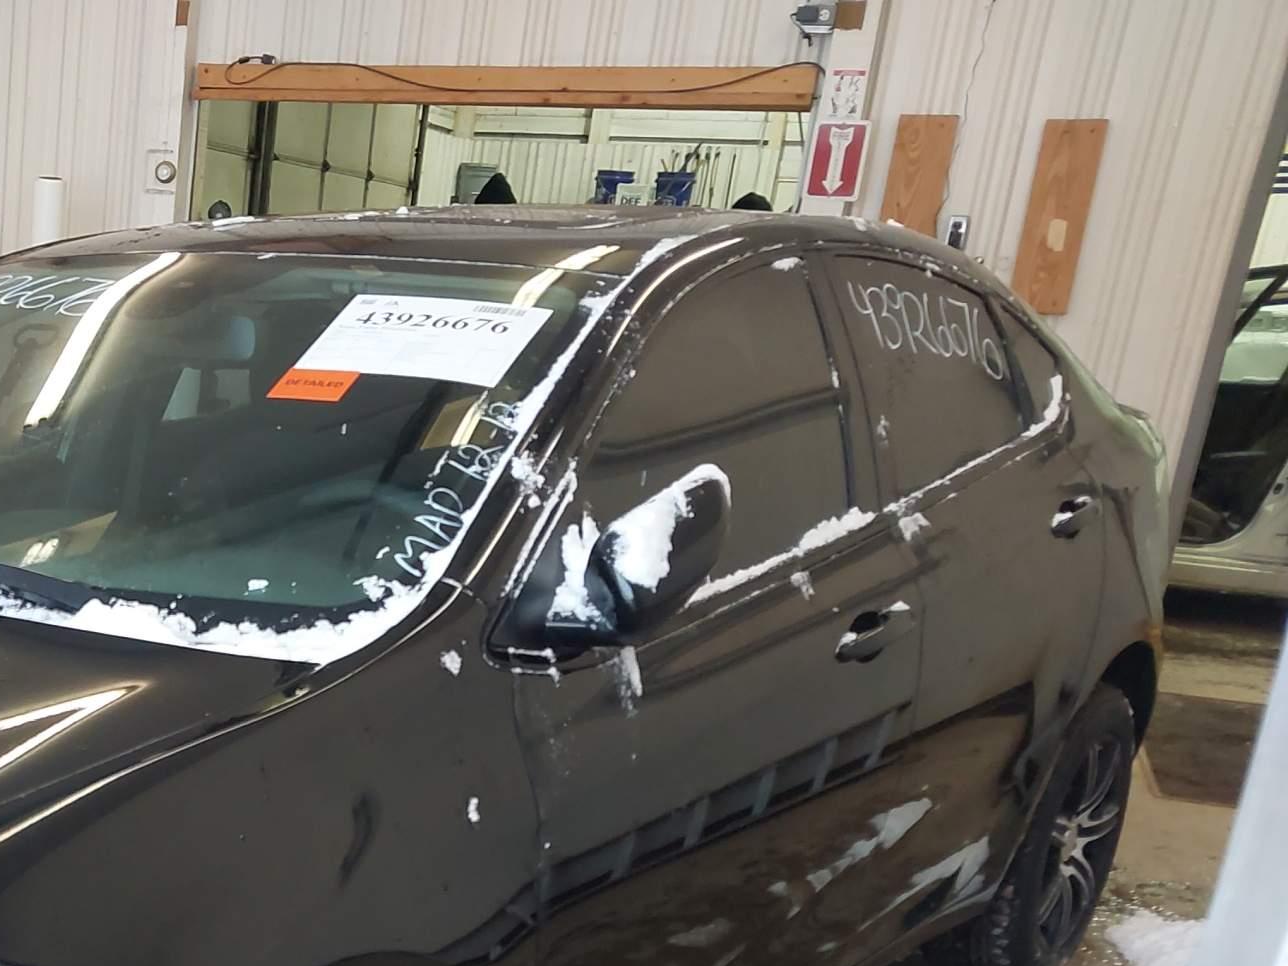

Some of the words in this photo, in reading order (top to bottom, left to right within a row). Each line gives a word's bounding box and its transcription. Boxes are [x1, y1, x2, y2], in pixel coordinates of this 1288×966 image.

[355, 310, 512, 336] 43926676
[284, 377, 345, 389] DETAILED
[394, 487, 464, 577] MAD
